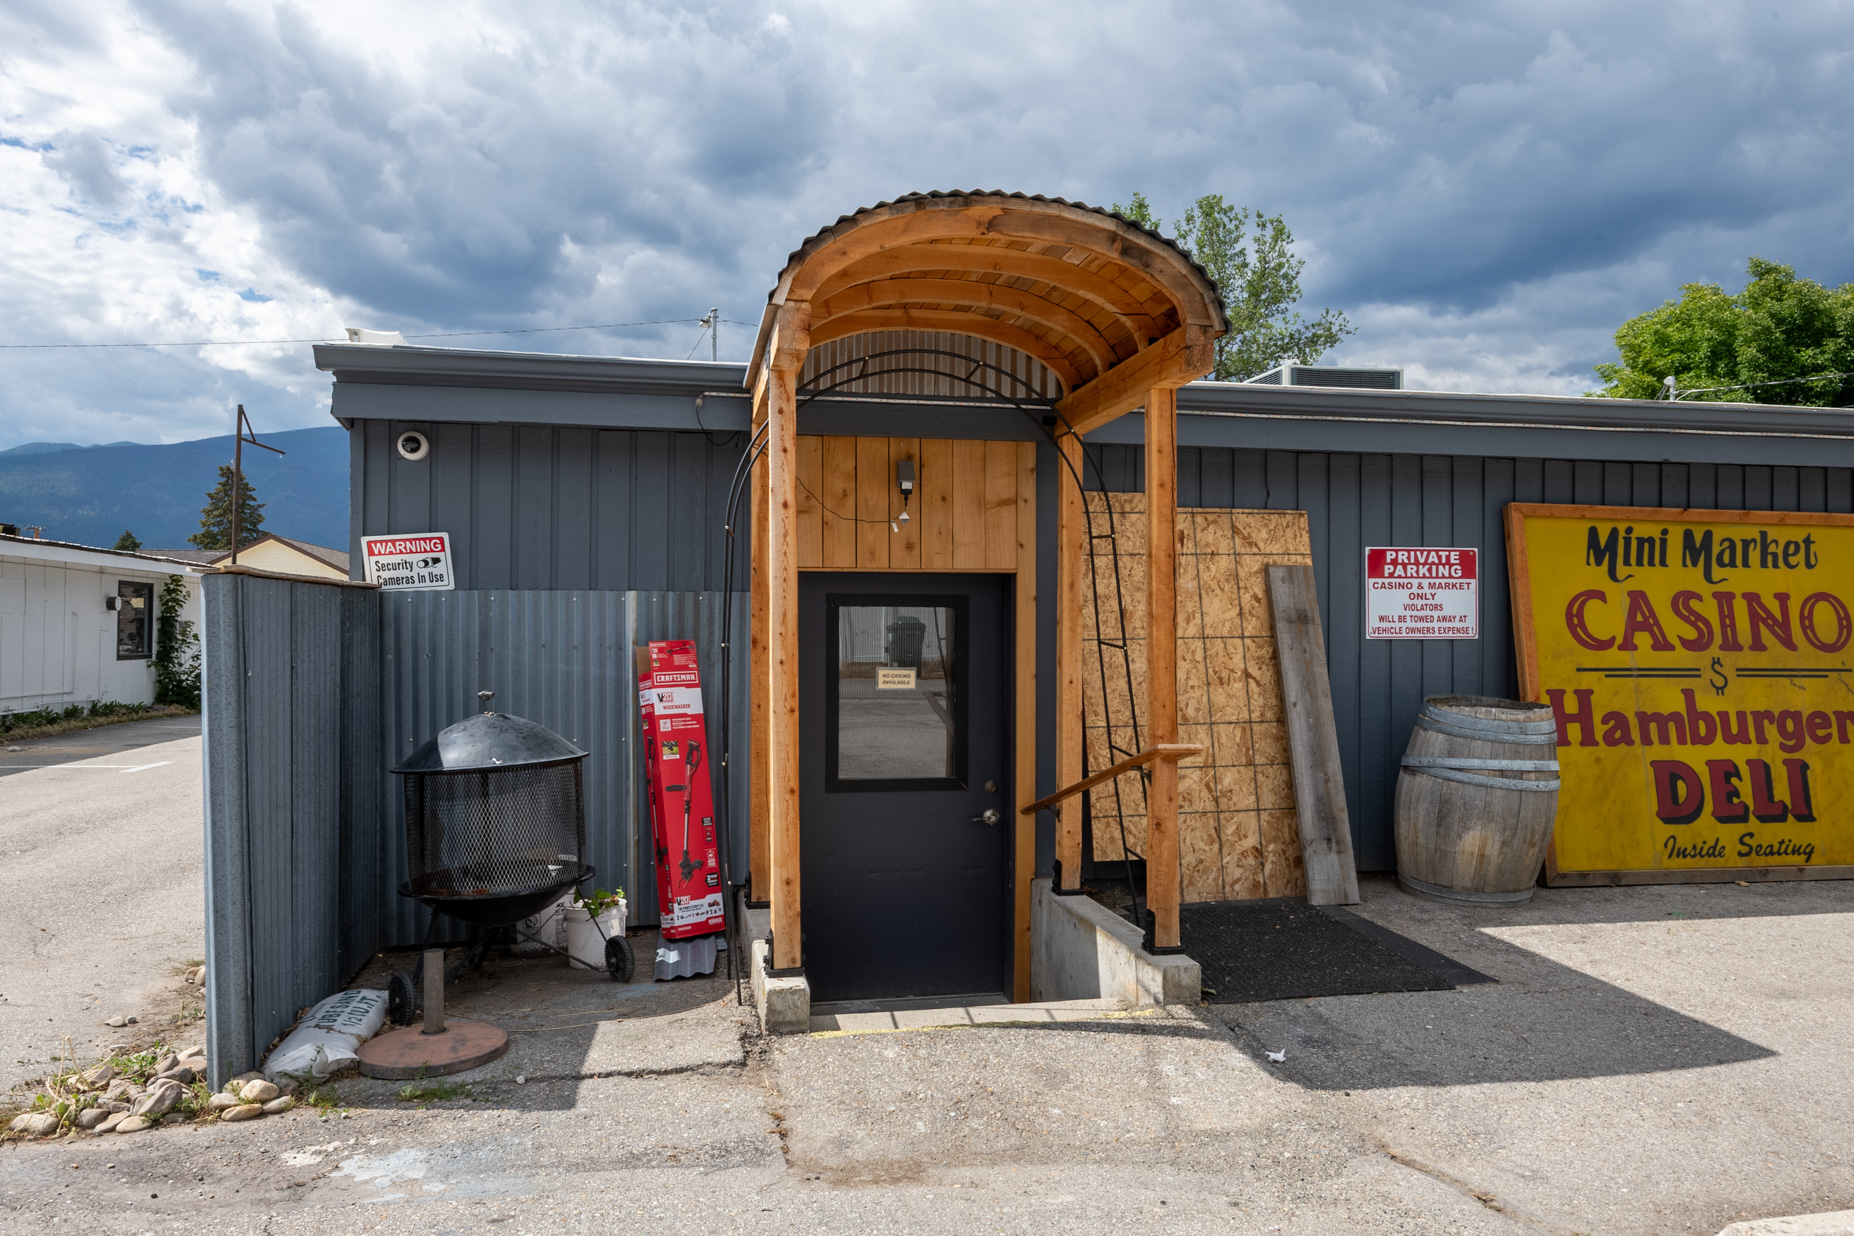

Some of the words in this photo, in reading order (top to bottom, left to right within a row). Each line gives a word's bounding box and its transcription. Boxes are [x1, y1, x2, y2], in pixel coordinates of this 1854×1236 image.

[371, 539, 442, 555] WARNING
[1386, 550, 1460, 564] PRIVATE
[1586, 525, 1670, 583] Mini
[1681, 528, 1818, 585] Market
[374, 559, 414, 572] Security
[1383, 564, 1462, 578] PARKING
[377, 574, 415, 587] Cameras
[417, 572, 427, 584] In
[428, 571, 445, 583] Use
[1372, 581, 1413, 590] CASINO
[1416, 581, 1424, 590] &
[1427, 581, 1472, 590] MARKET
[1408, 592, 1437, 601] ONLY
[1402, 603, 1444, 612] VIOLATORS
[1378, 614, 1396, 623] WILL
[1398, 614, 1408, 623] BE
[1409, 614, 1435, 623] TOWED
[1436, 614, 1457, 623] AWAY
[1458, 614, 1468, 623] AT
[1565, 589, 1853, 653] CASINO
[1371, 626, 1403, 635] VEHICLE
[1404, 626, 1436, 635] OWNERS
[656, 674, 696, 682] CRAFTSMAN
[657, 692, 672, 702] V20
[1545, 688, 1854, 754] Hamburger
[1650, 758, 1817, 825] DELI
[1663, 835, 1726, 860] Inside
[1737, 832, 1815, 863] Seating
